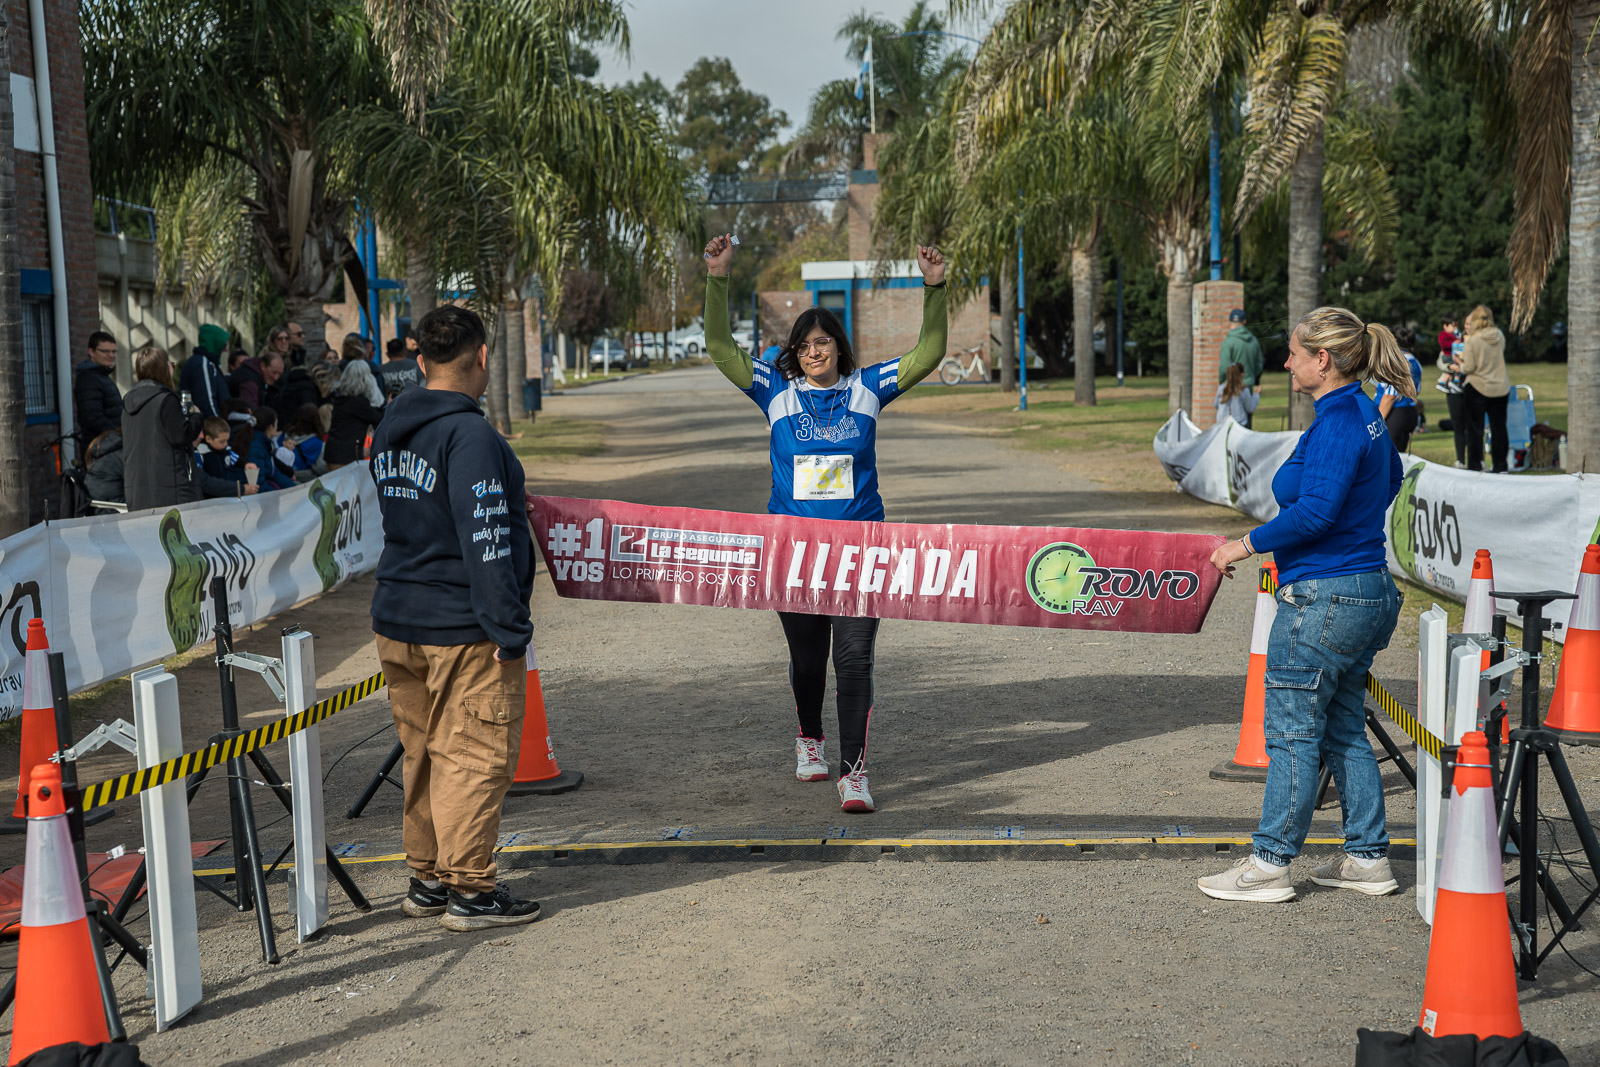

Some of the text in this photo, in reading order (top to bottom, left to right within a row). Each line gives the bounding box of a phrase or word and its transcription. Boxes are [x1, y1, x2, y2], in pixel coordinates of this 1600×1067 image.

[795, 413, 814, 441] 3
[472, 479, 488, 499] El
[801, 466, 846, 490] 731
[485, 499, 509, 523] puebl
[472, 527, 492, 542] más
[547, 517, 606, 559] #1
[652, 530, 758, 546] GRUPO ASEGURADOR
[482, 544, 497, 563] del
[673, 546, 757, 565] segunda
[553, 560, 605, 582] VOS
[612, 566, 757, 588] LO PRIMERO SOS VOS
[786, 541, 978, 598] LLEGADA
[1071, 599, 1124, 617] RAV
